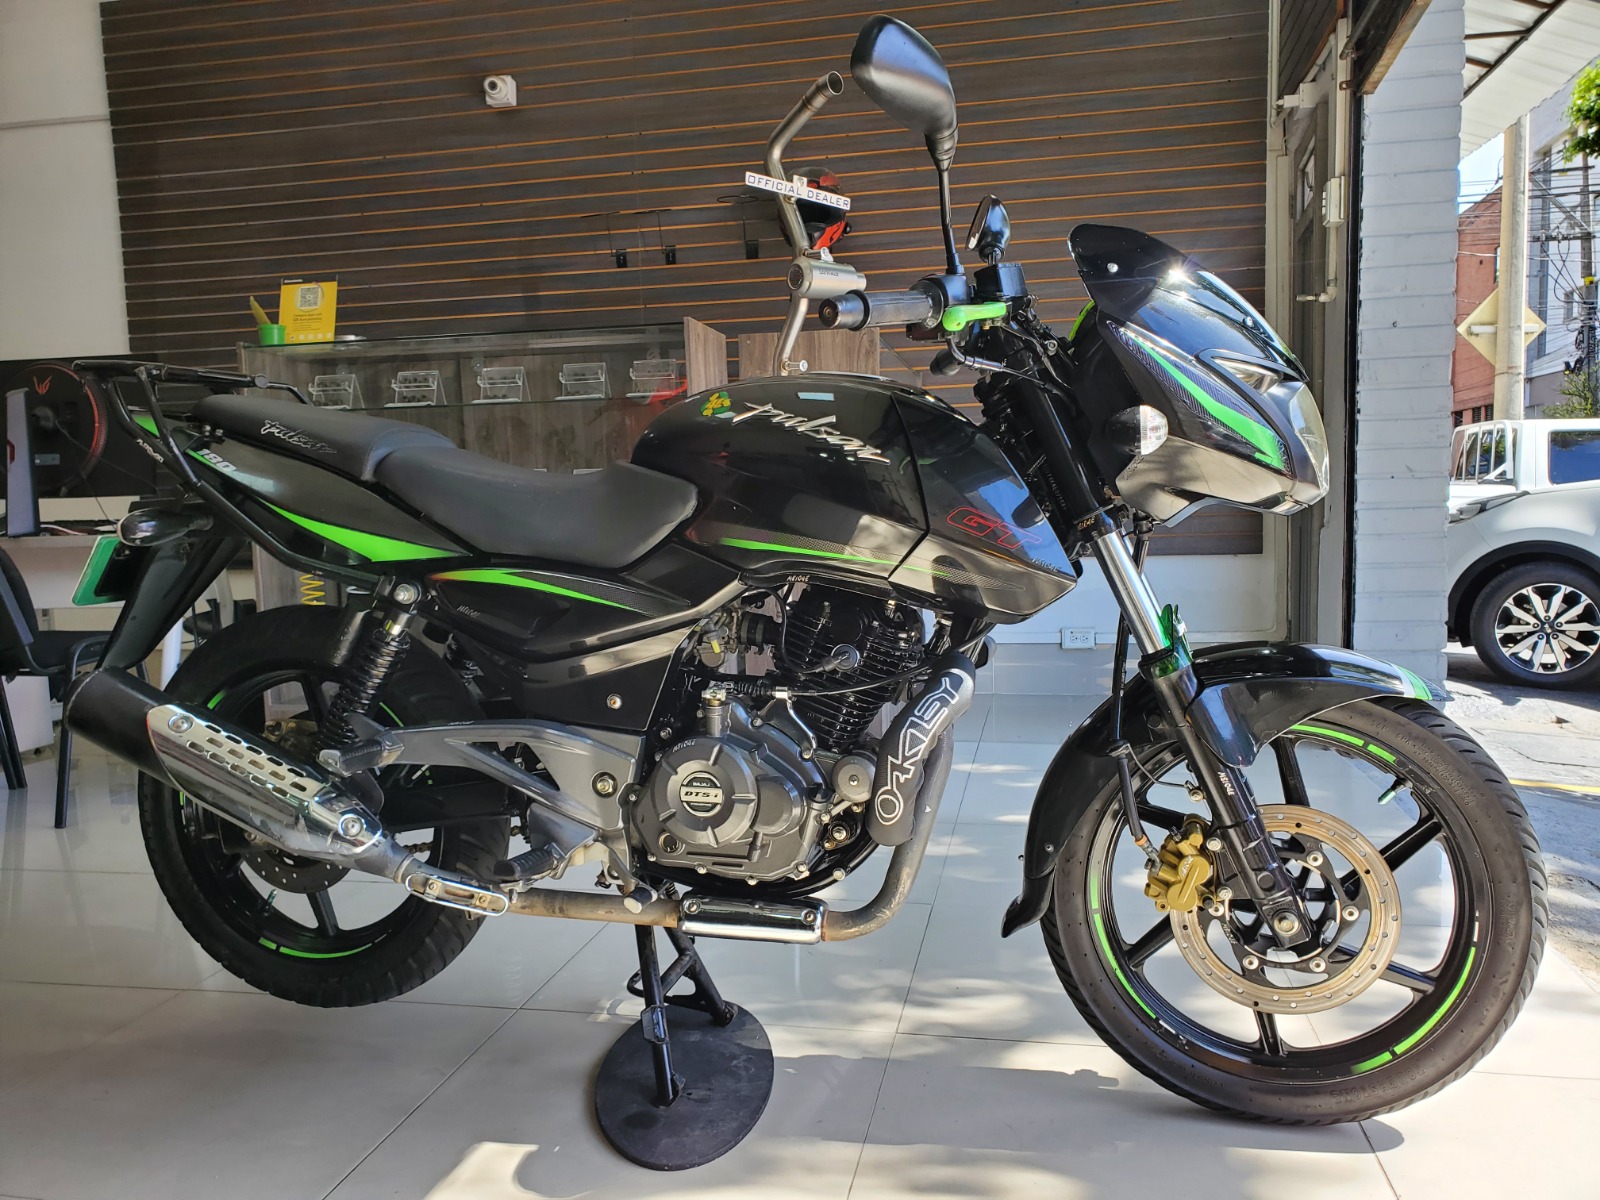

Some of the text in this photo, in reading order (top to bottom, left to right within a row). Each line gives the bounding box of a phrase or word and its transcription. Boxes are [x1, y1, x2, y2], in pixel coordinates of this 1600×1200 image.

[747, 174, 849, 208] OFFICIAL DEALER
[196, 448, 237, 472] 180
[946, 506, 1043, 550] GT
[684, 790, 719, 798] DTS-i
